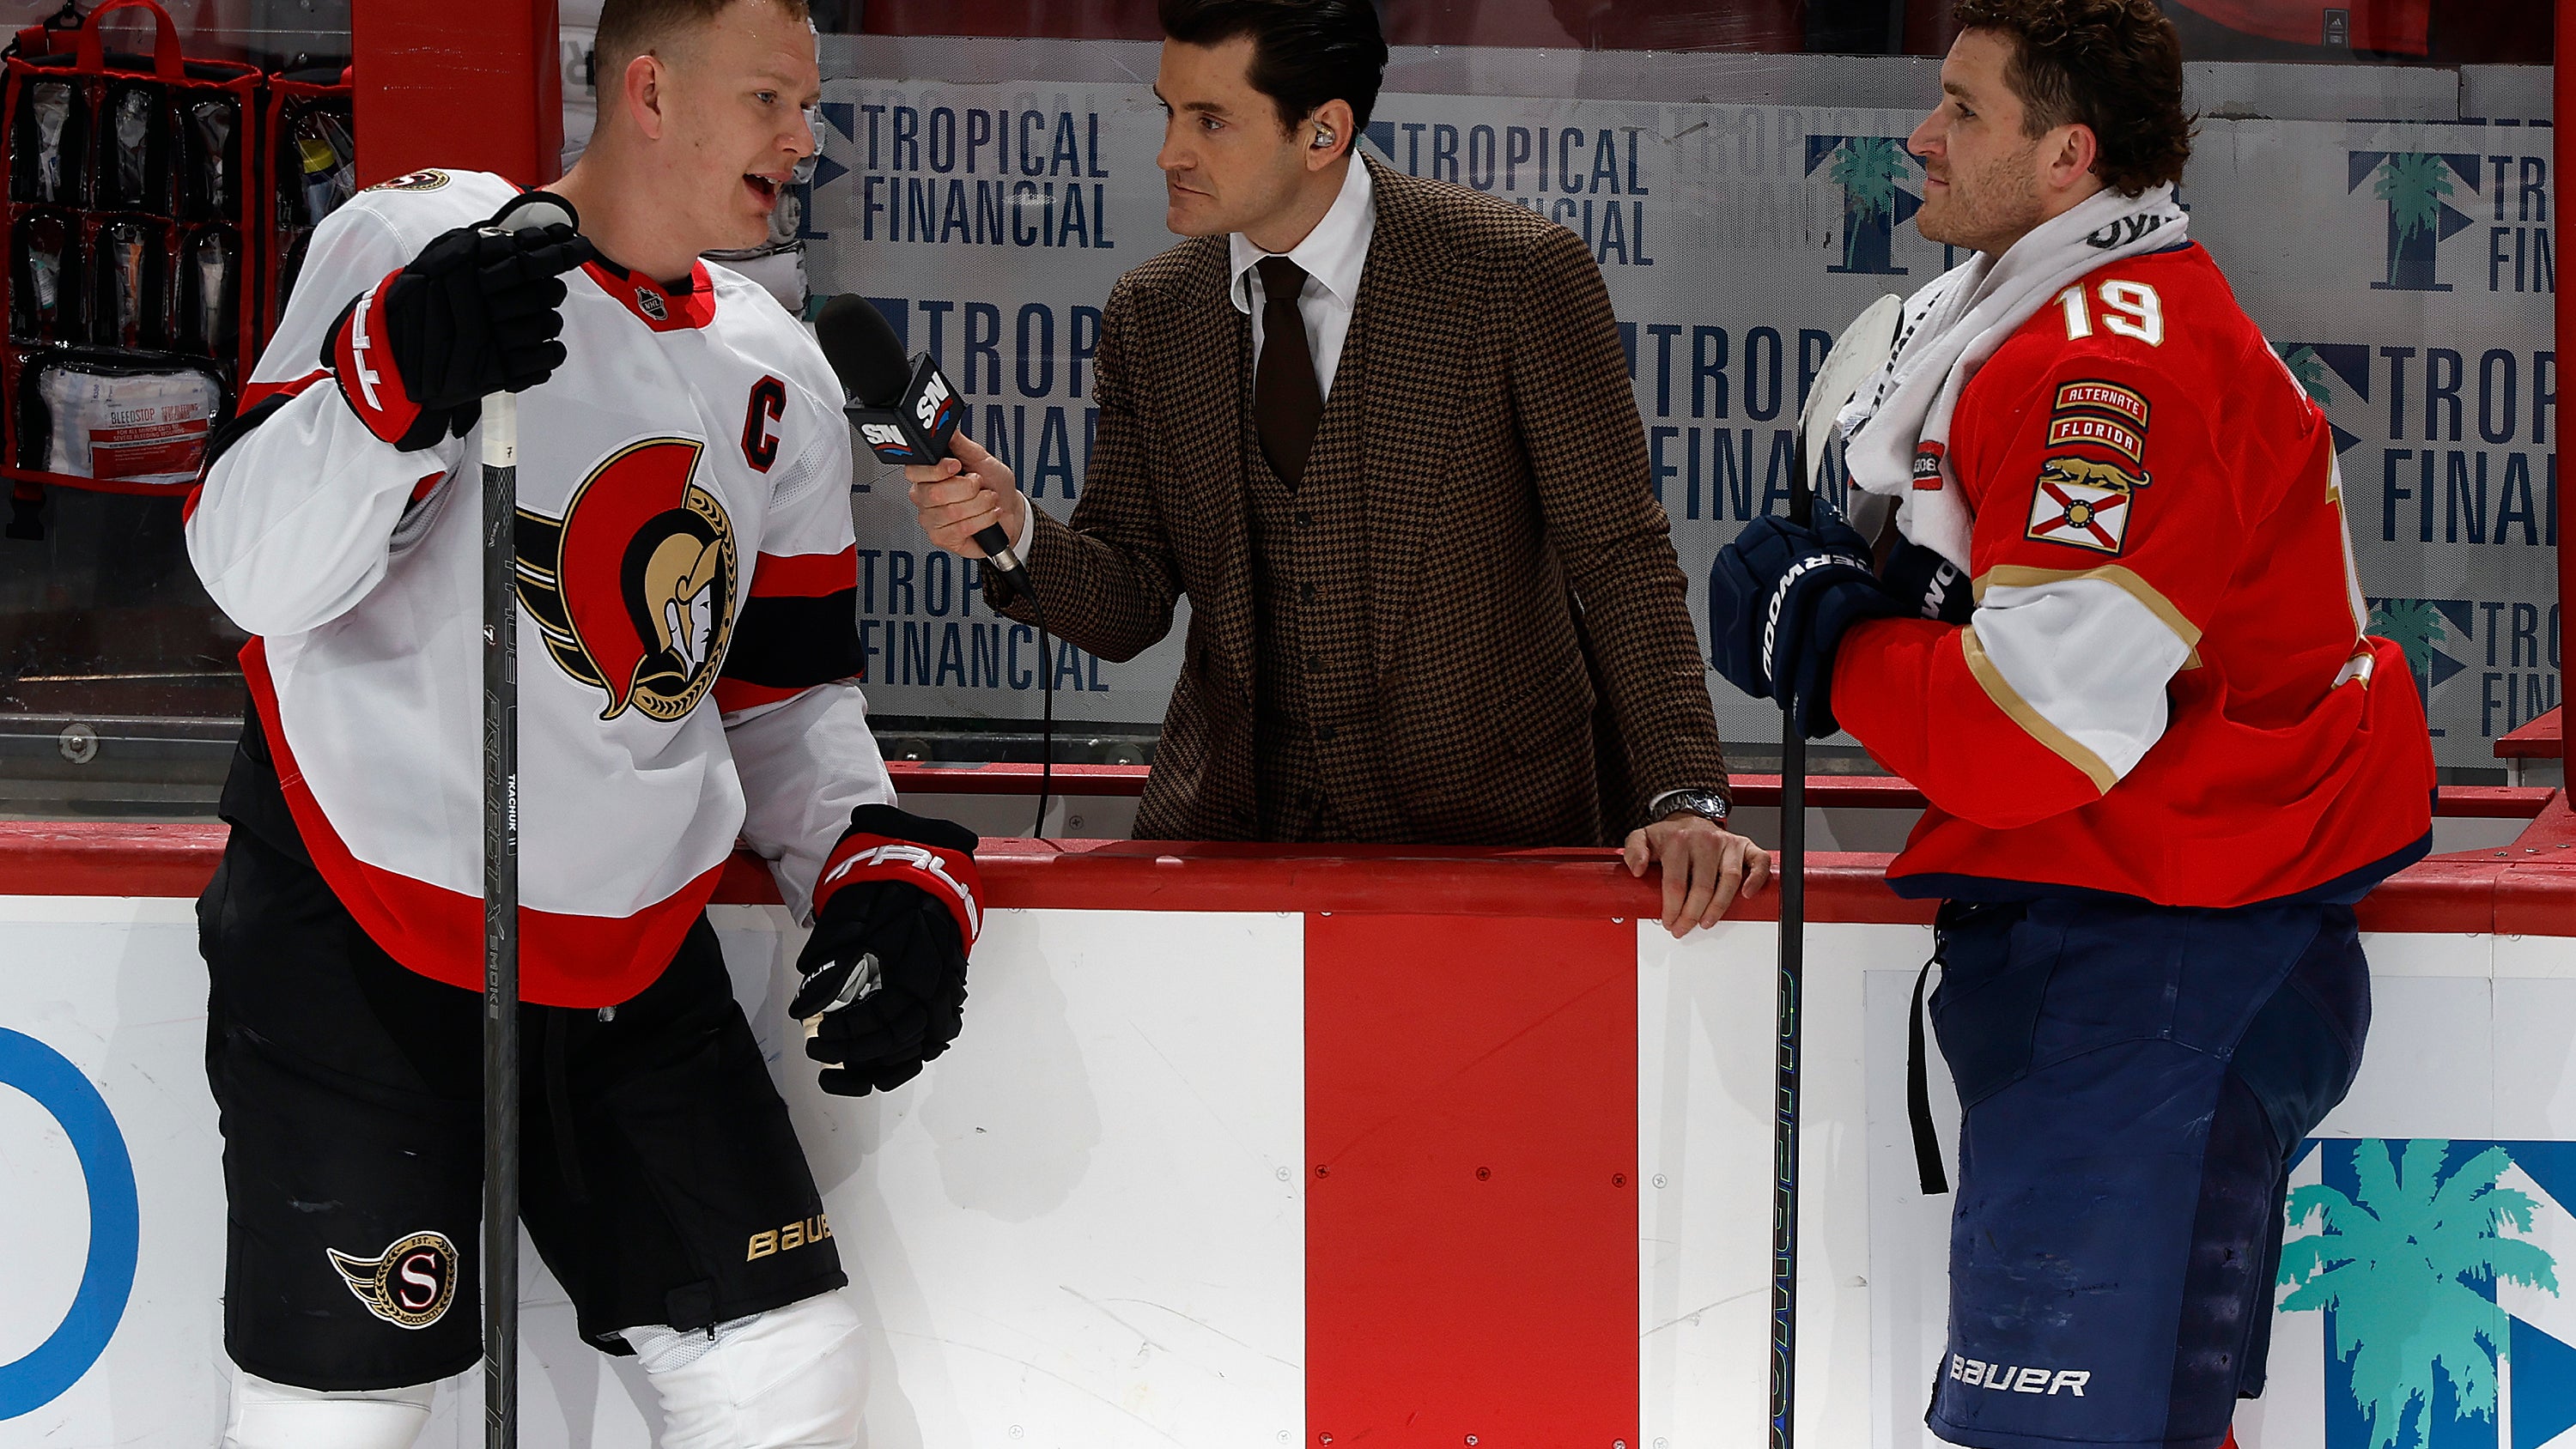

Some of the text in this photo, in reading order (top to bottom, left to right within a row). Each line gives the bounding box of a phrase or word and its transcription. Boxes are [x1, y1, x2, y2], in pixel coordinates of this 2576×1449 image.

[861, 105, 1109, 179] TROPICAL
[1402, 123, 1649, 196] TROPICAL
[863, 176, 1114, 249] FINANCIAL
[2053, 279, 2165, 348] 19
[111, 408, 155, 424] BLEEDSTOP
[741, 374, 787, 474] C
[916, 371, 950, 429] SN
[2069, 387, 2141, 415] ALTERNATE
[861, 423, 908, 446] SN
[2061, 421, 2134, 451] FLORIDA
[507, 773, 517, 831] TKACHUK
[399, 1252, 437, 1310] S
[1949, 1353, 2091, 1397] BAUER
